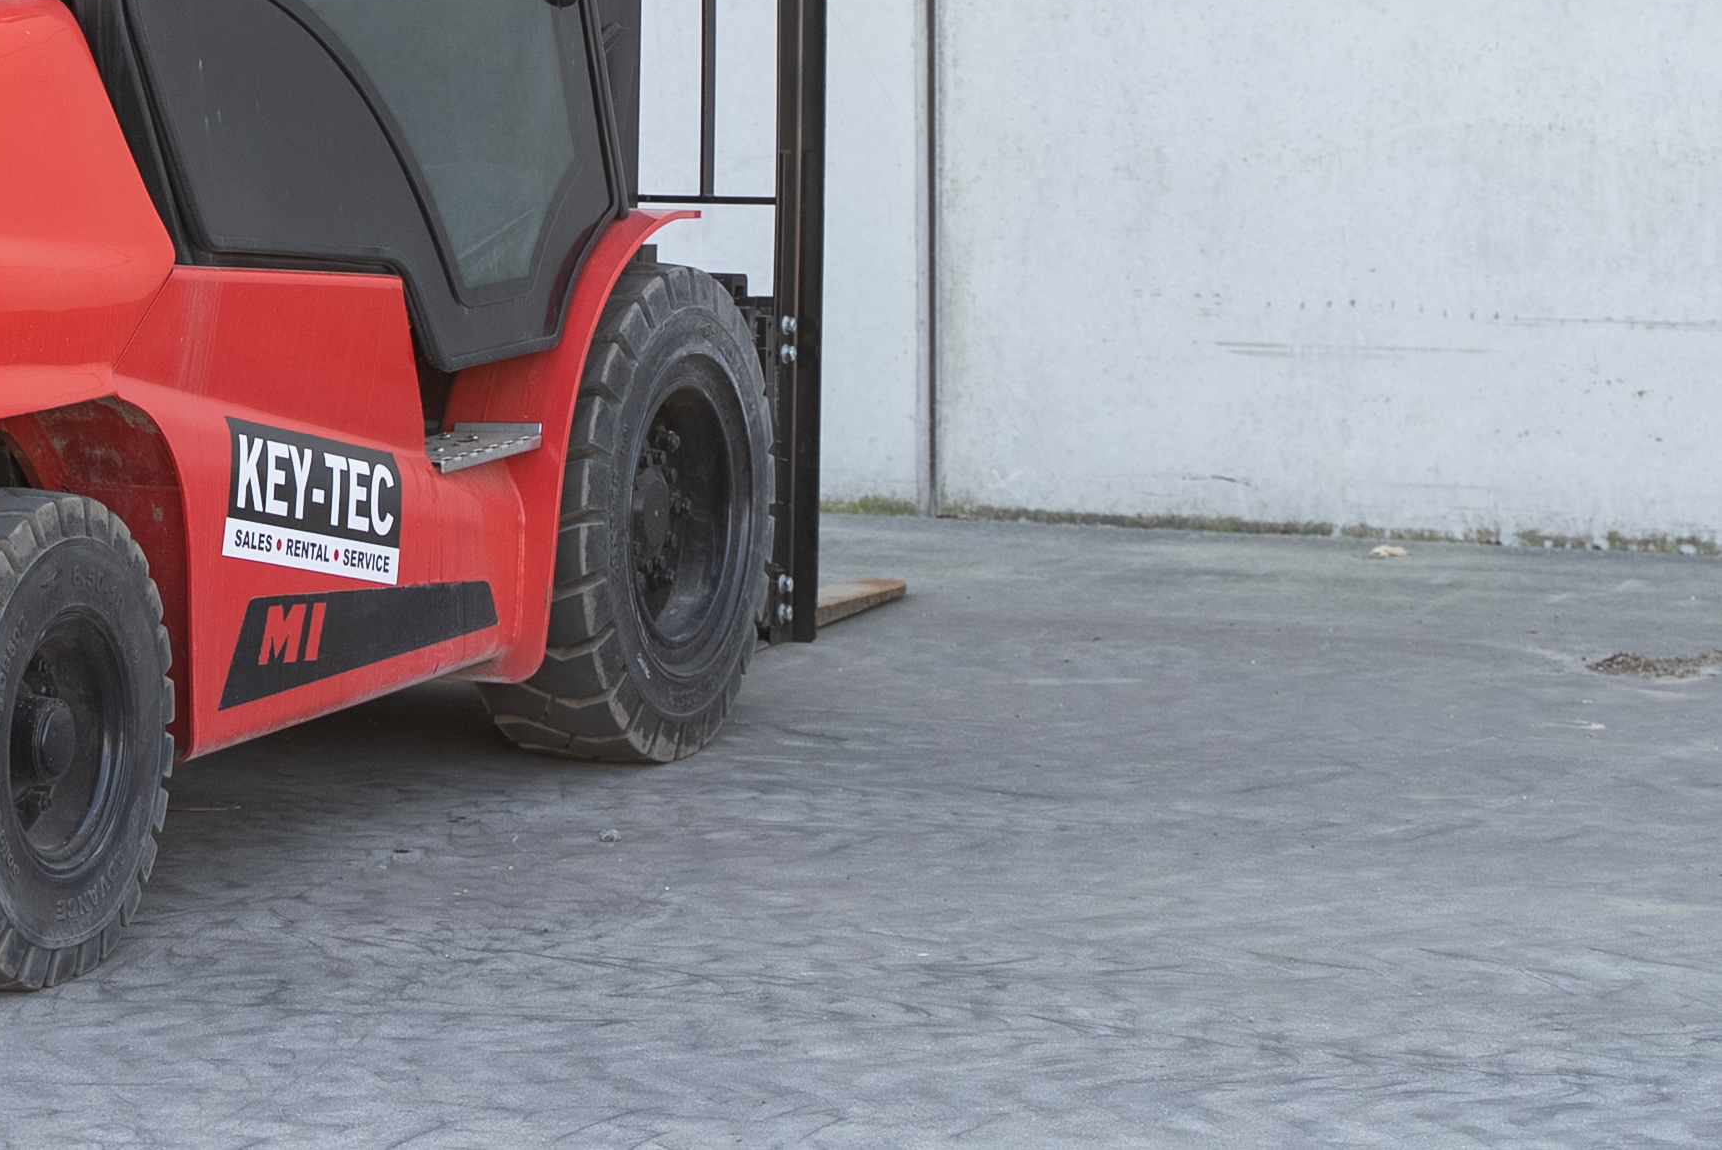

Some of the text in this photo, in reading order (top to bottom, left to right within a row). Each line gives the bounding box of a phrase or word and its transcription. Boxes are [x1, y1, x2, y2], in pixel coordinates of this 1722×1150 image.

[236, 433, 395, 536] KEY-TEC
[234, 529, 391, 574] SALES RENTAL SERVICE
[258, 602, 327, 666] MI
